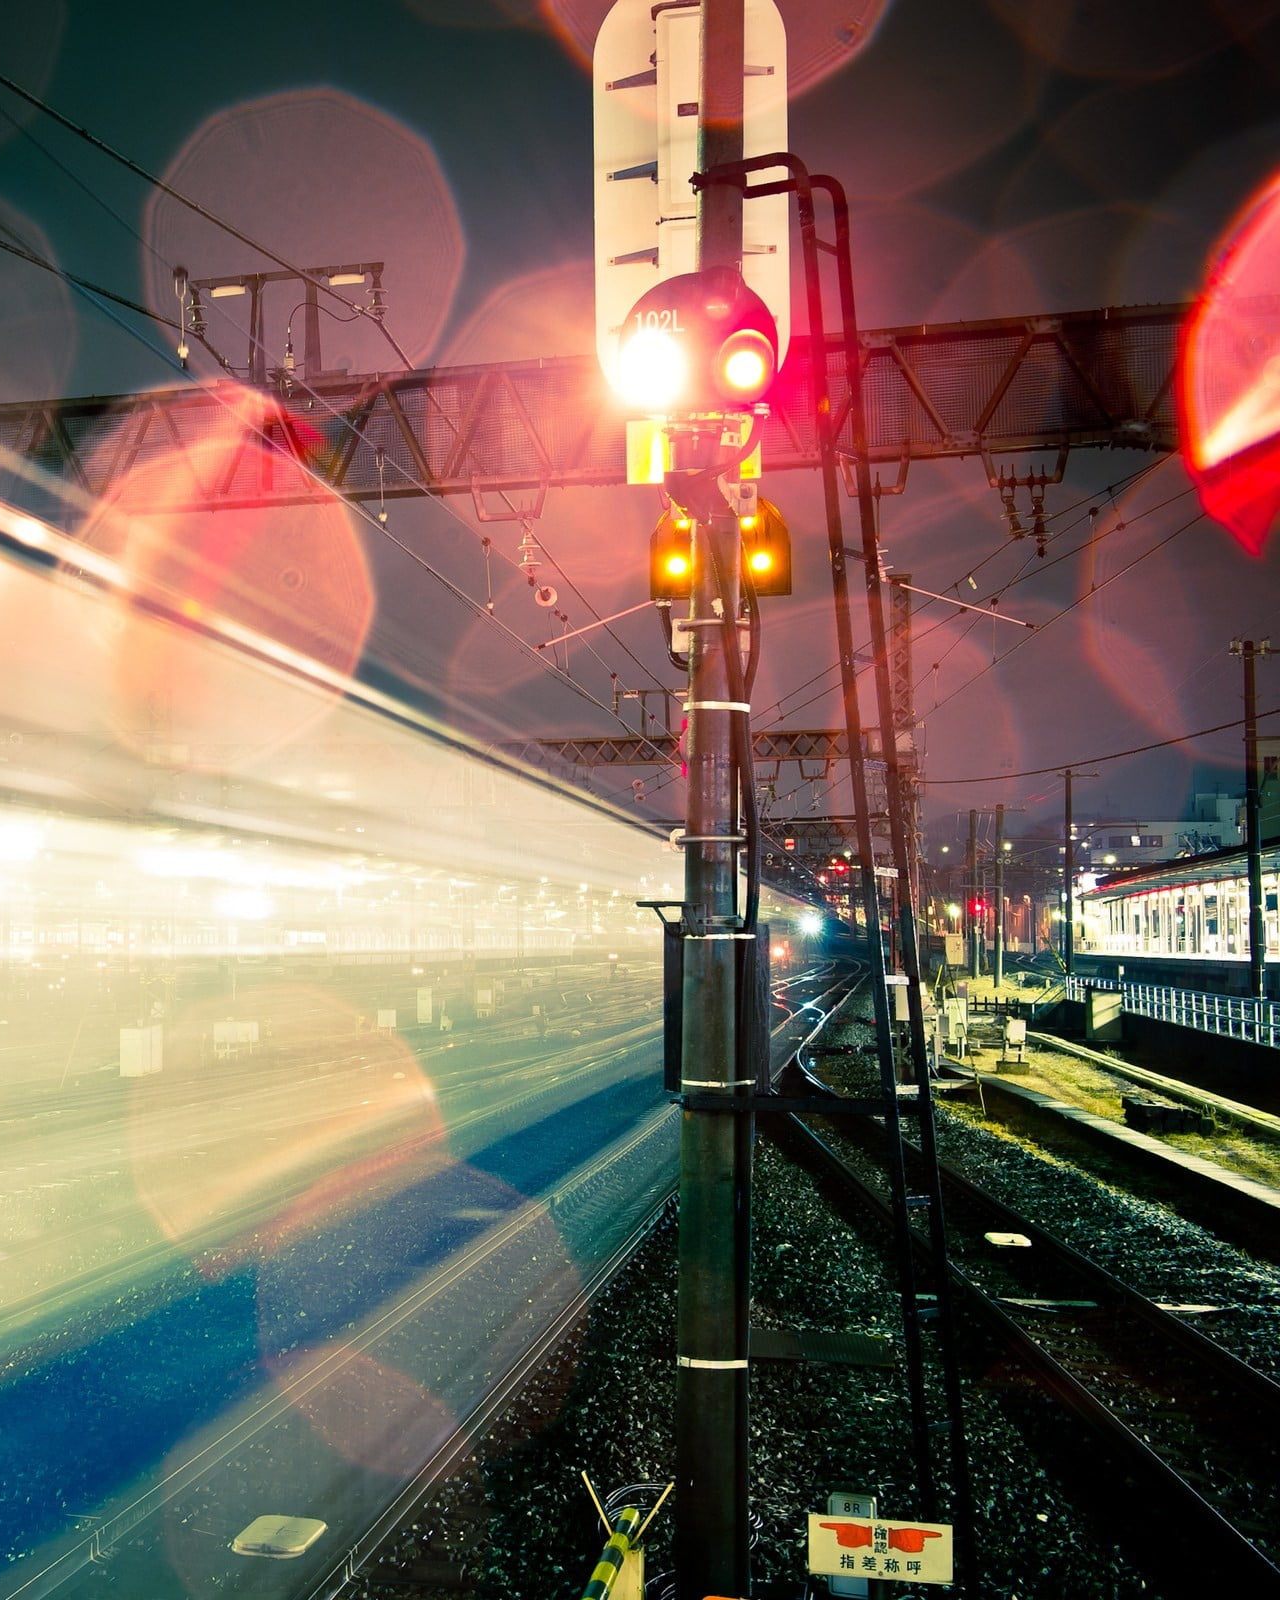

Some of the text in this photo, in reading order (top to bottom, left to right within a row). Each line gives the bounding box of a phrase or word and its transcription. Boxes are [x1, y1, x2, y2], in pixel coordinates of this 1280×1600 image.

[634, 309, 685, 333] 102L
[844, 1502, 861, 1513] 8R
[874, 1527, 888, 1554] 確認
[840, 1554, 922, 1575] 指差称呼
